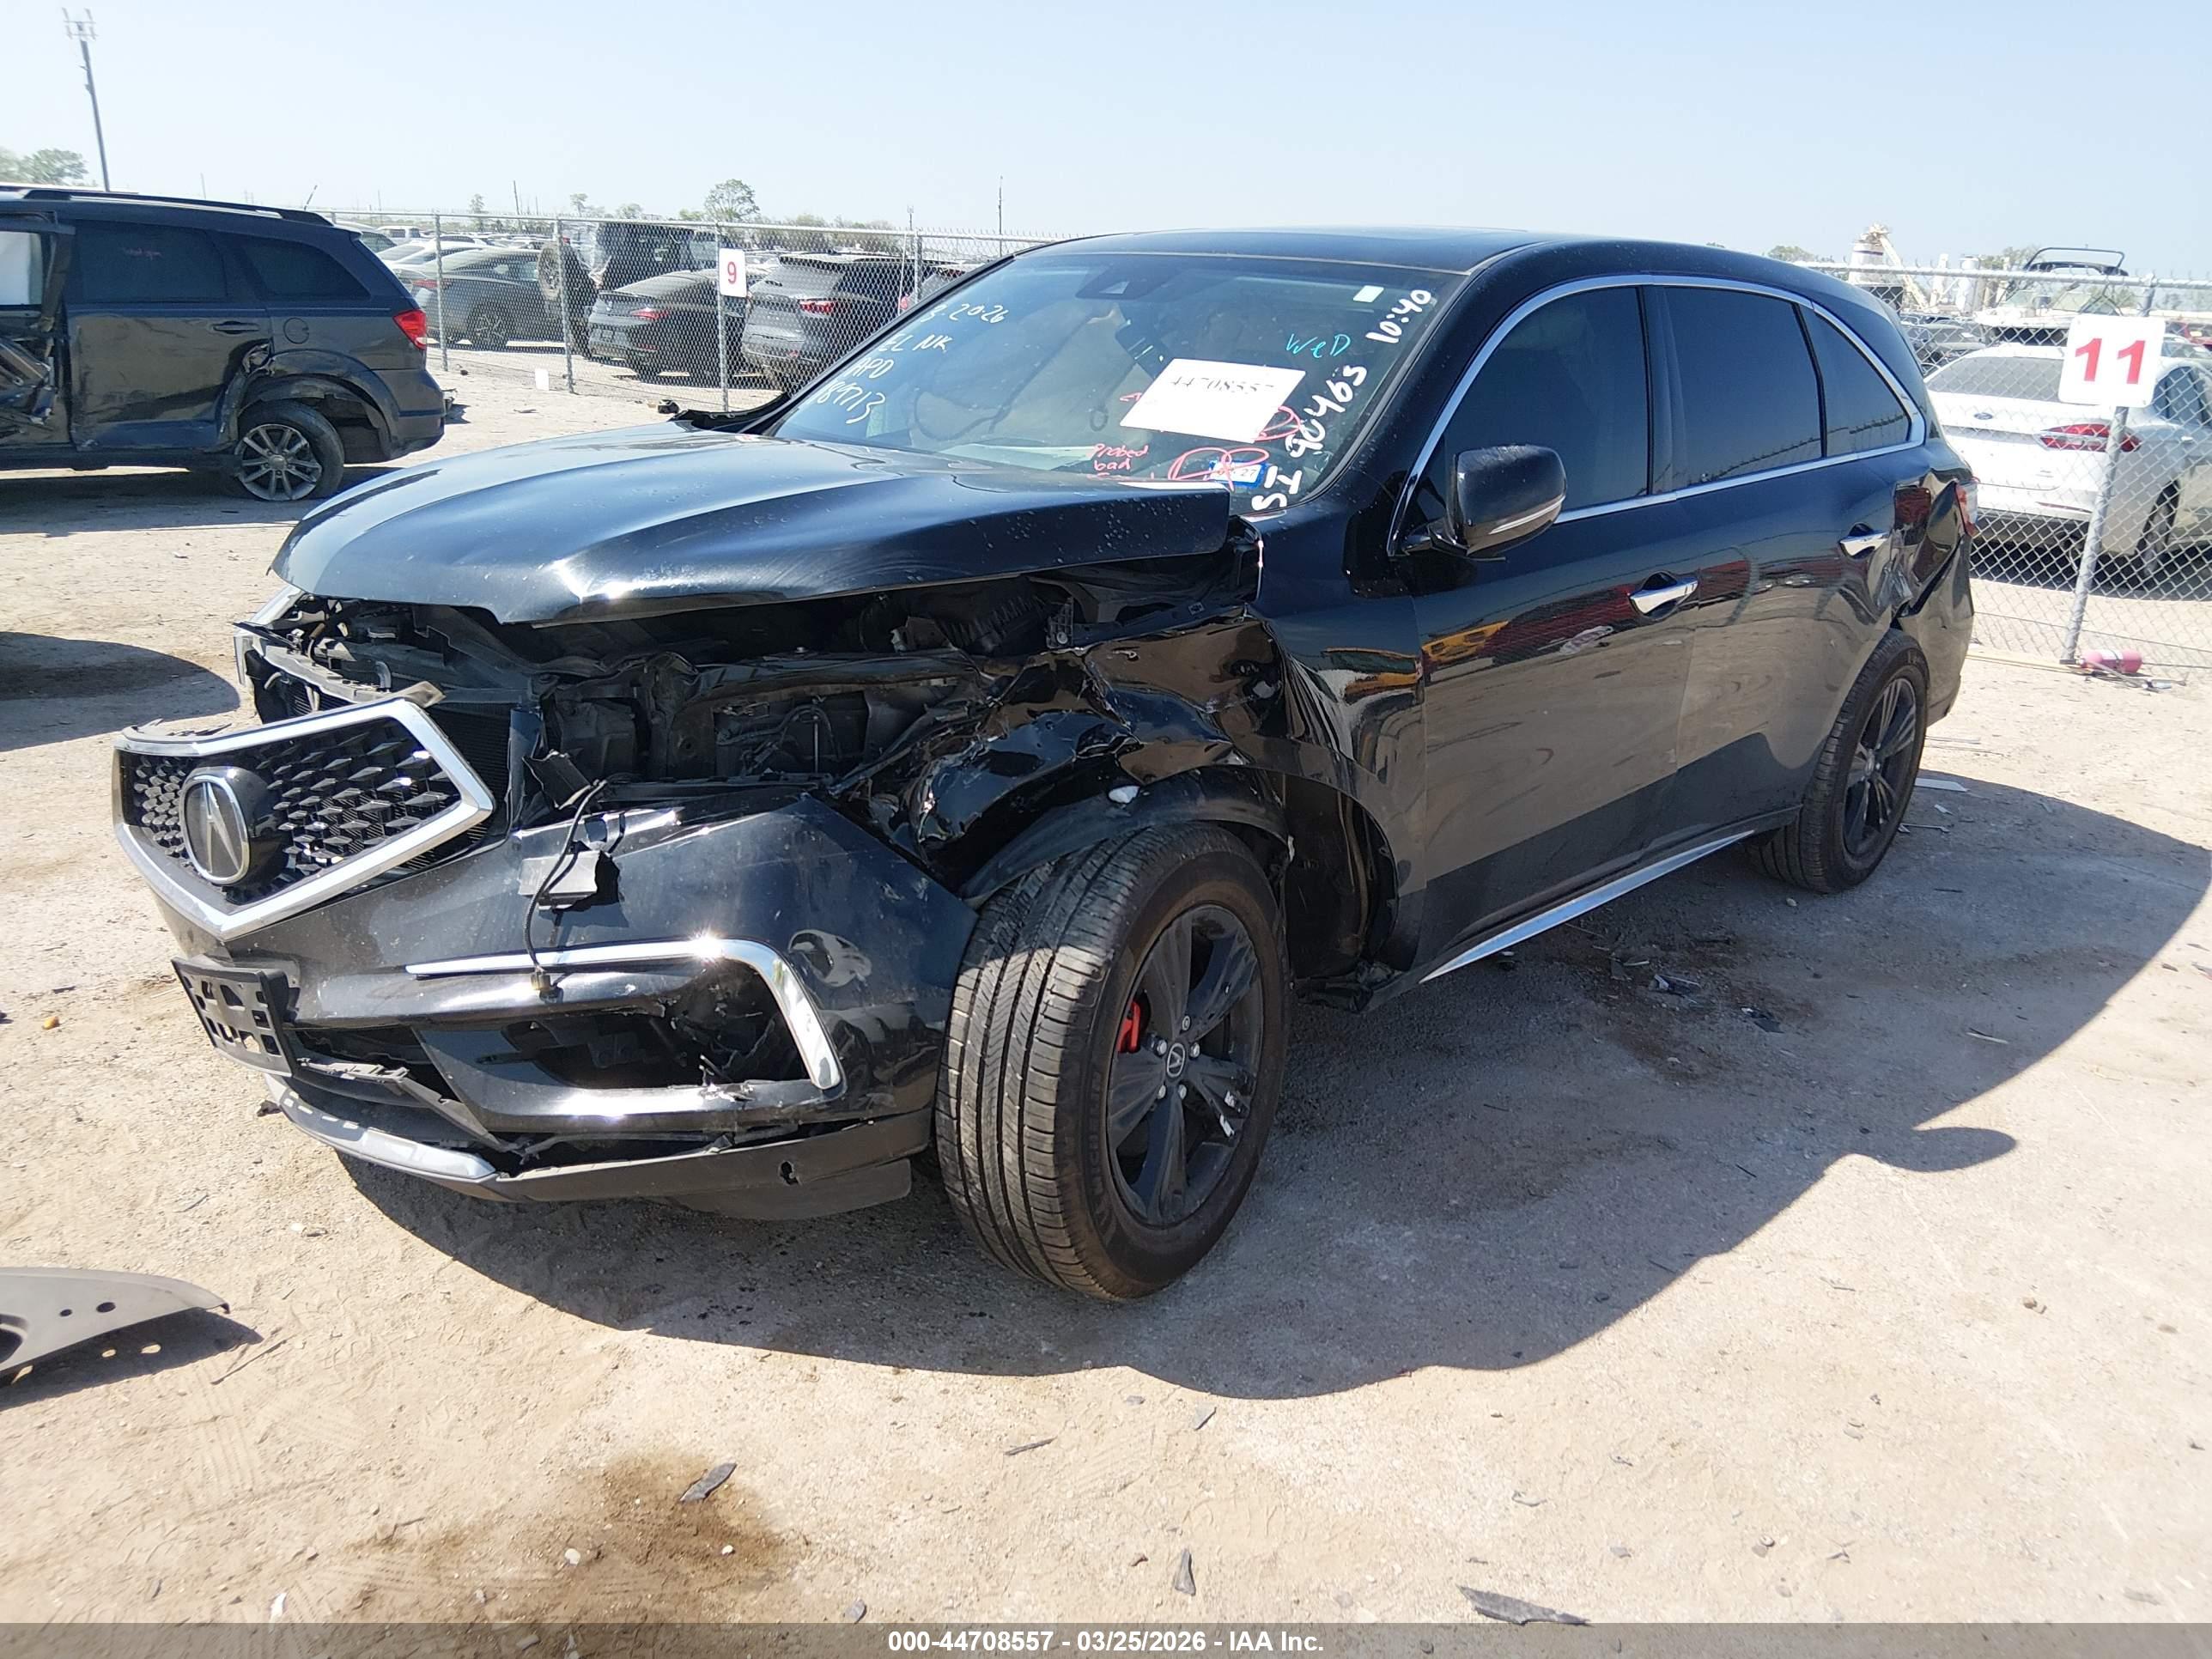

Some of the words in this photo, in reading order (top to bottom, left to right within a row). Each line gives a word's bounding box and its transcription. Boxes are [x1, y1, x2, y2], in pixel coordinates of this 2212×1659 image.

[727, 261, 737, 284] 9
[1366, 289, 1432, 343] 10:40
[2075, 337, 2146, 385] 11
